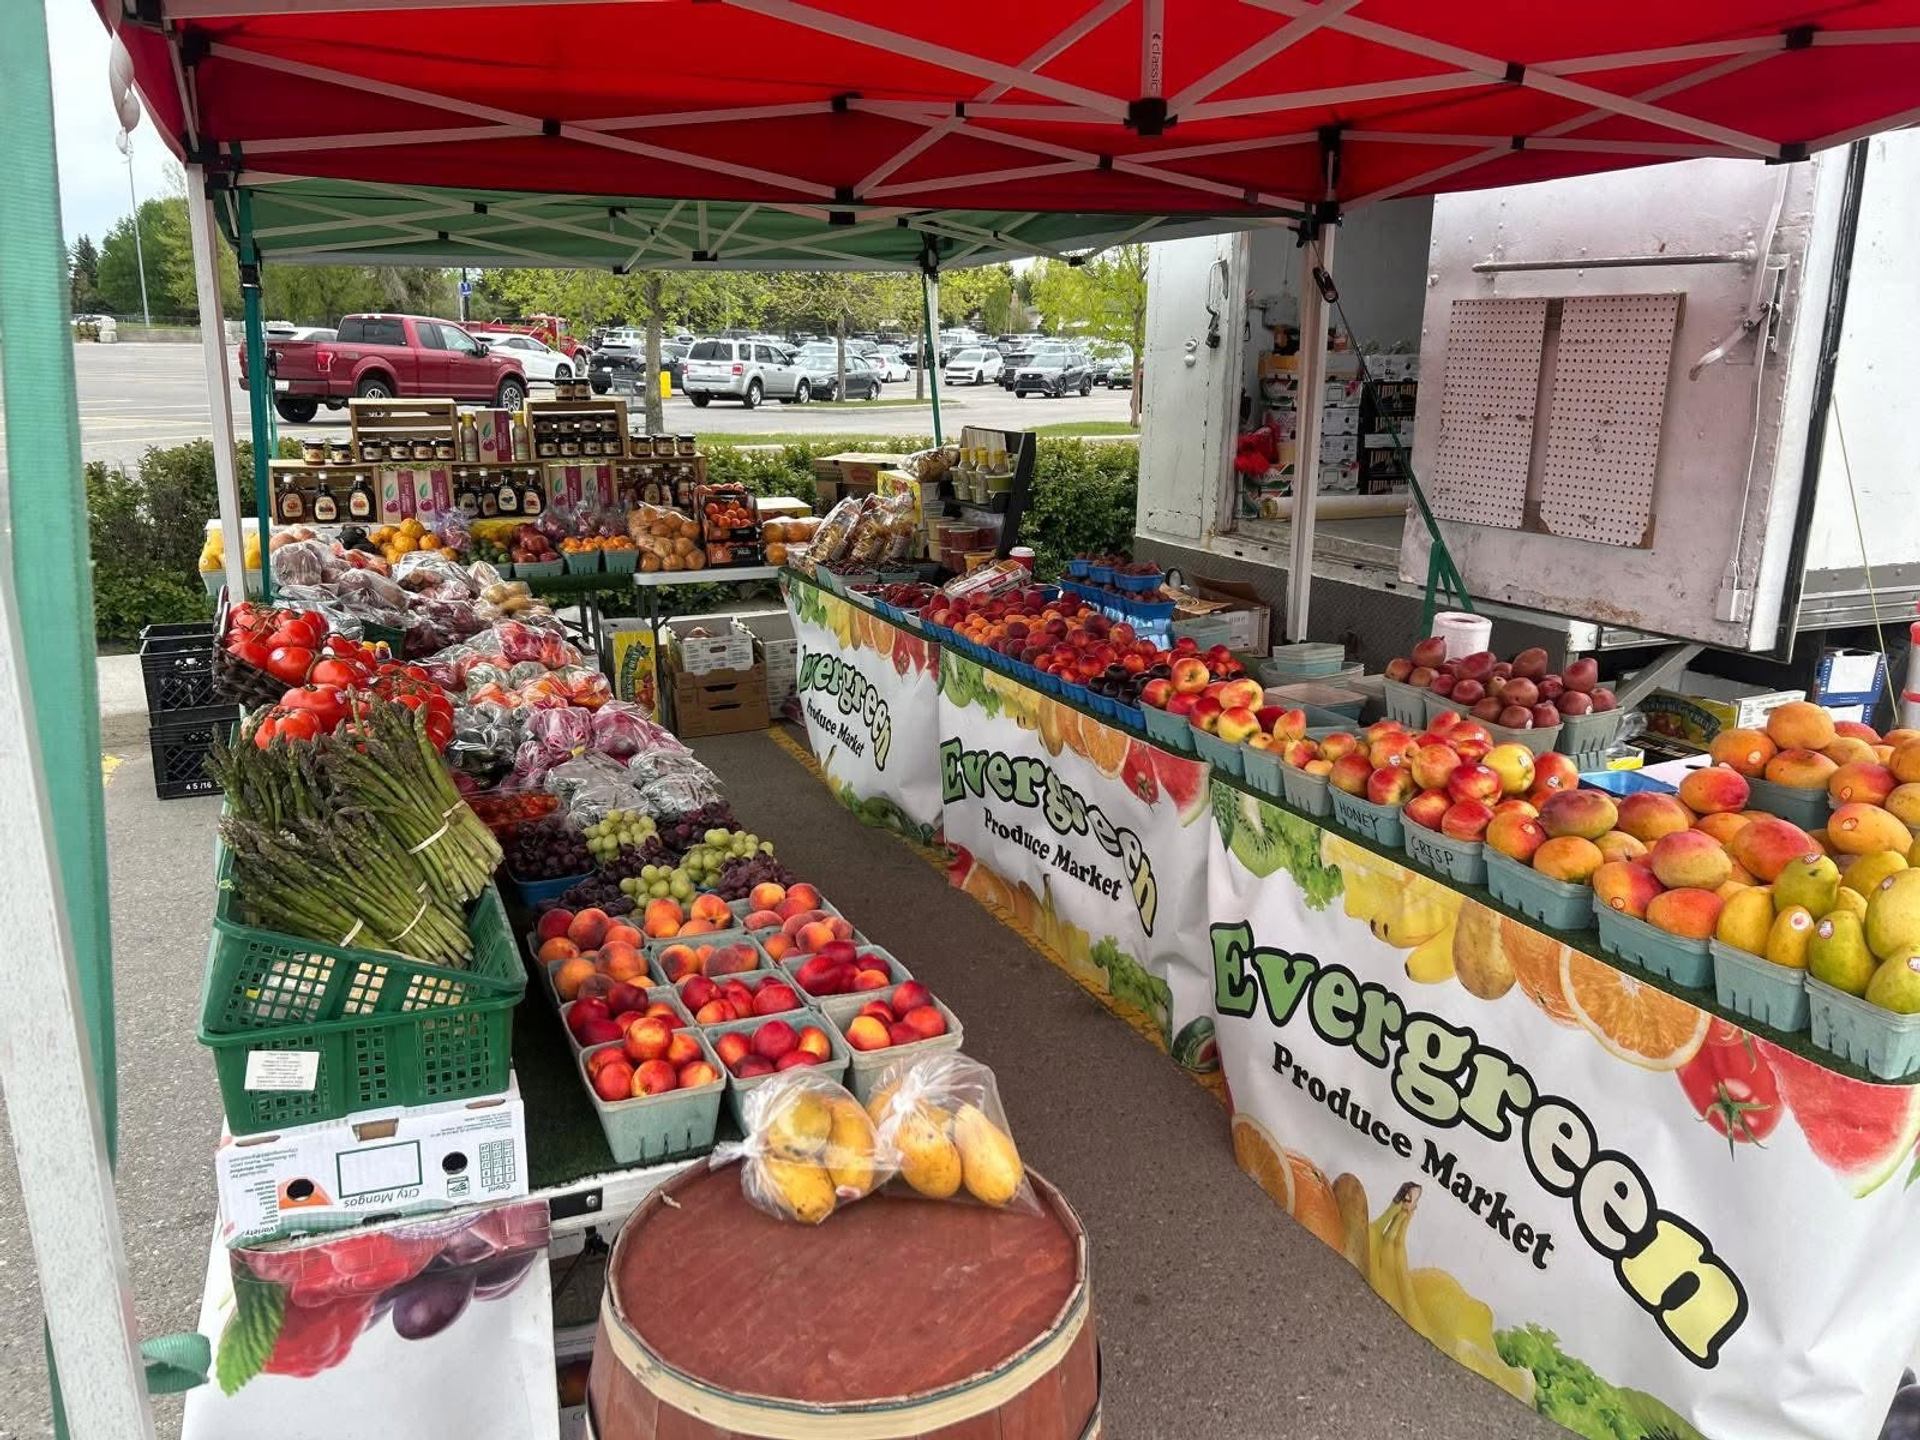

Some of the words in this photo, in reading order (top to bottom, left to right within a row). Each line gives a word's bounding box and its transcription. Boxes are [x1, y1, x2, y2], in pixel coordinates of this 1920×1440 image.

[837, 722, 865, 758] Market
[1338, 801, 1379, 829] HONEY
[940, 736, 1158, 938] Evergreen
[1410, 835, 1454, 866] CRISP
[983, 806, 1051, 860] Produce
[1051, 843, 1123, 902] Market
[1210, 920, 1749, 1370] Evergreen
[1272, 1041, 1414, 1158] Produce
[1420, 1138, 1557, 1271] Market
[343, 1190, 390, 1208] Mangos
[391, 1187, 420, 1203] City
[486, 1183, 511, 1193] Count
